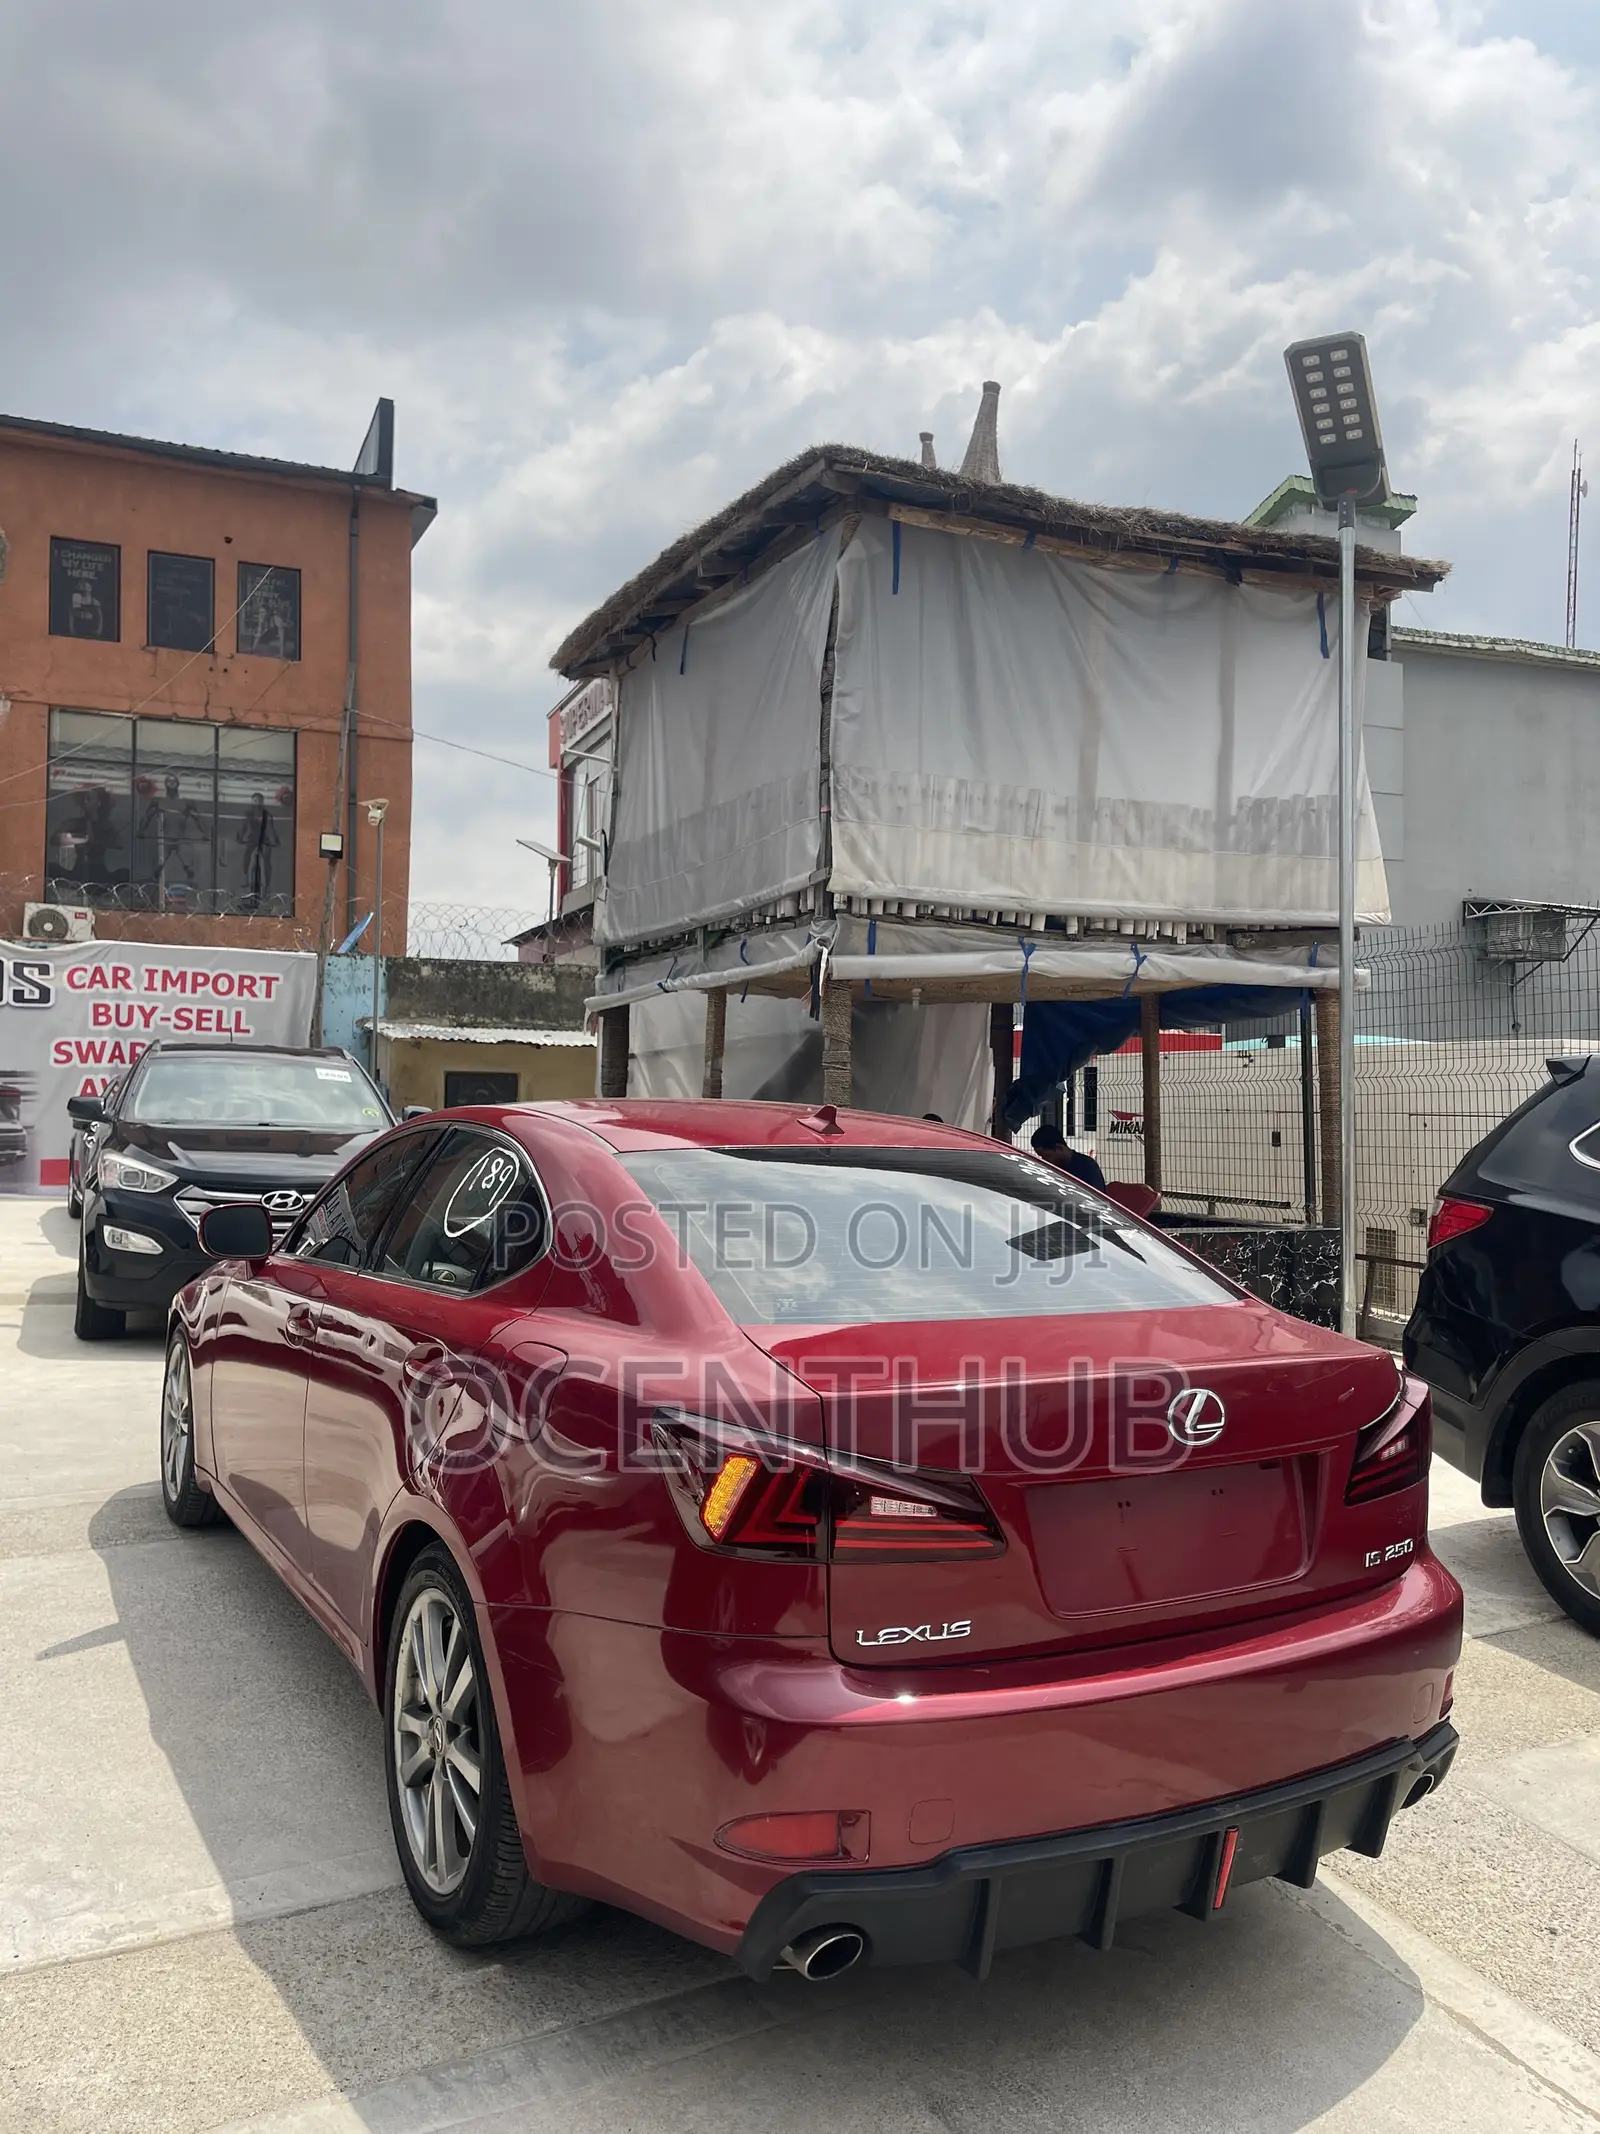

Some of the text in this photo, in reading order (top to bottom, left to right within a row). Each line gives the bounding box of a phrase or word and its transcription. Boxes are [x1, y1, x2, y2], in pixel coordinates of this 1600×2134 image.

[66, 965, 280, 999] CAR IMPORT
[92, 1003, 251, 1034] BUY-SELL
[1109, 1120, 1145, 1134] MIKA
[468, 1157, 514, 1207] 189
[1384, 1538, 1414, 1561] 250
[856, 1620, 972, 1646] LEXUS
